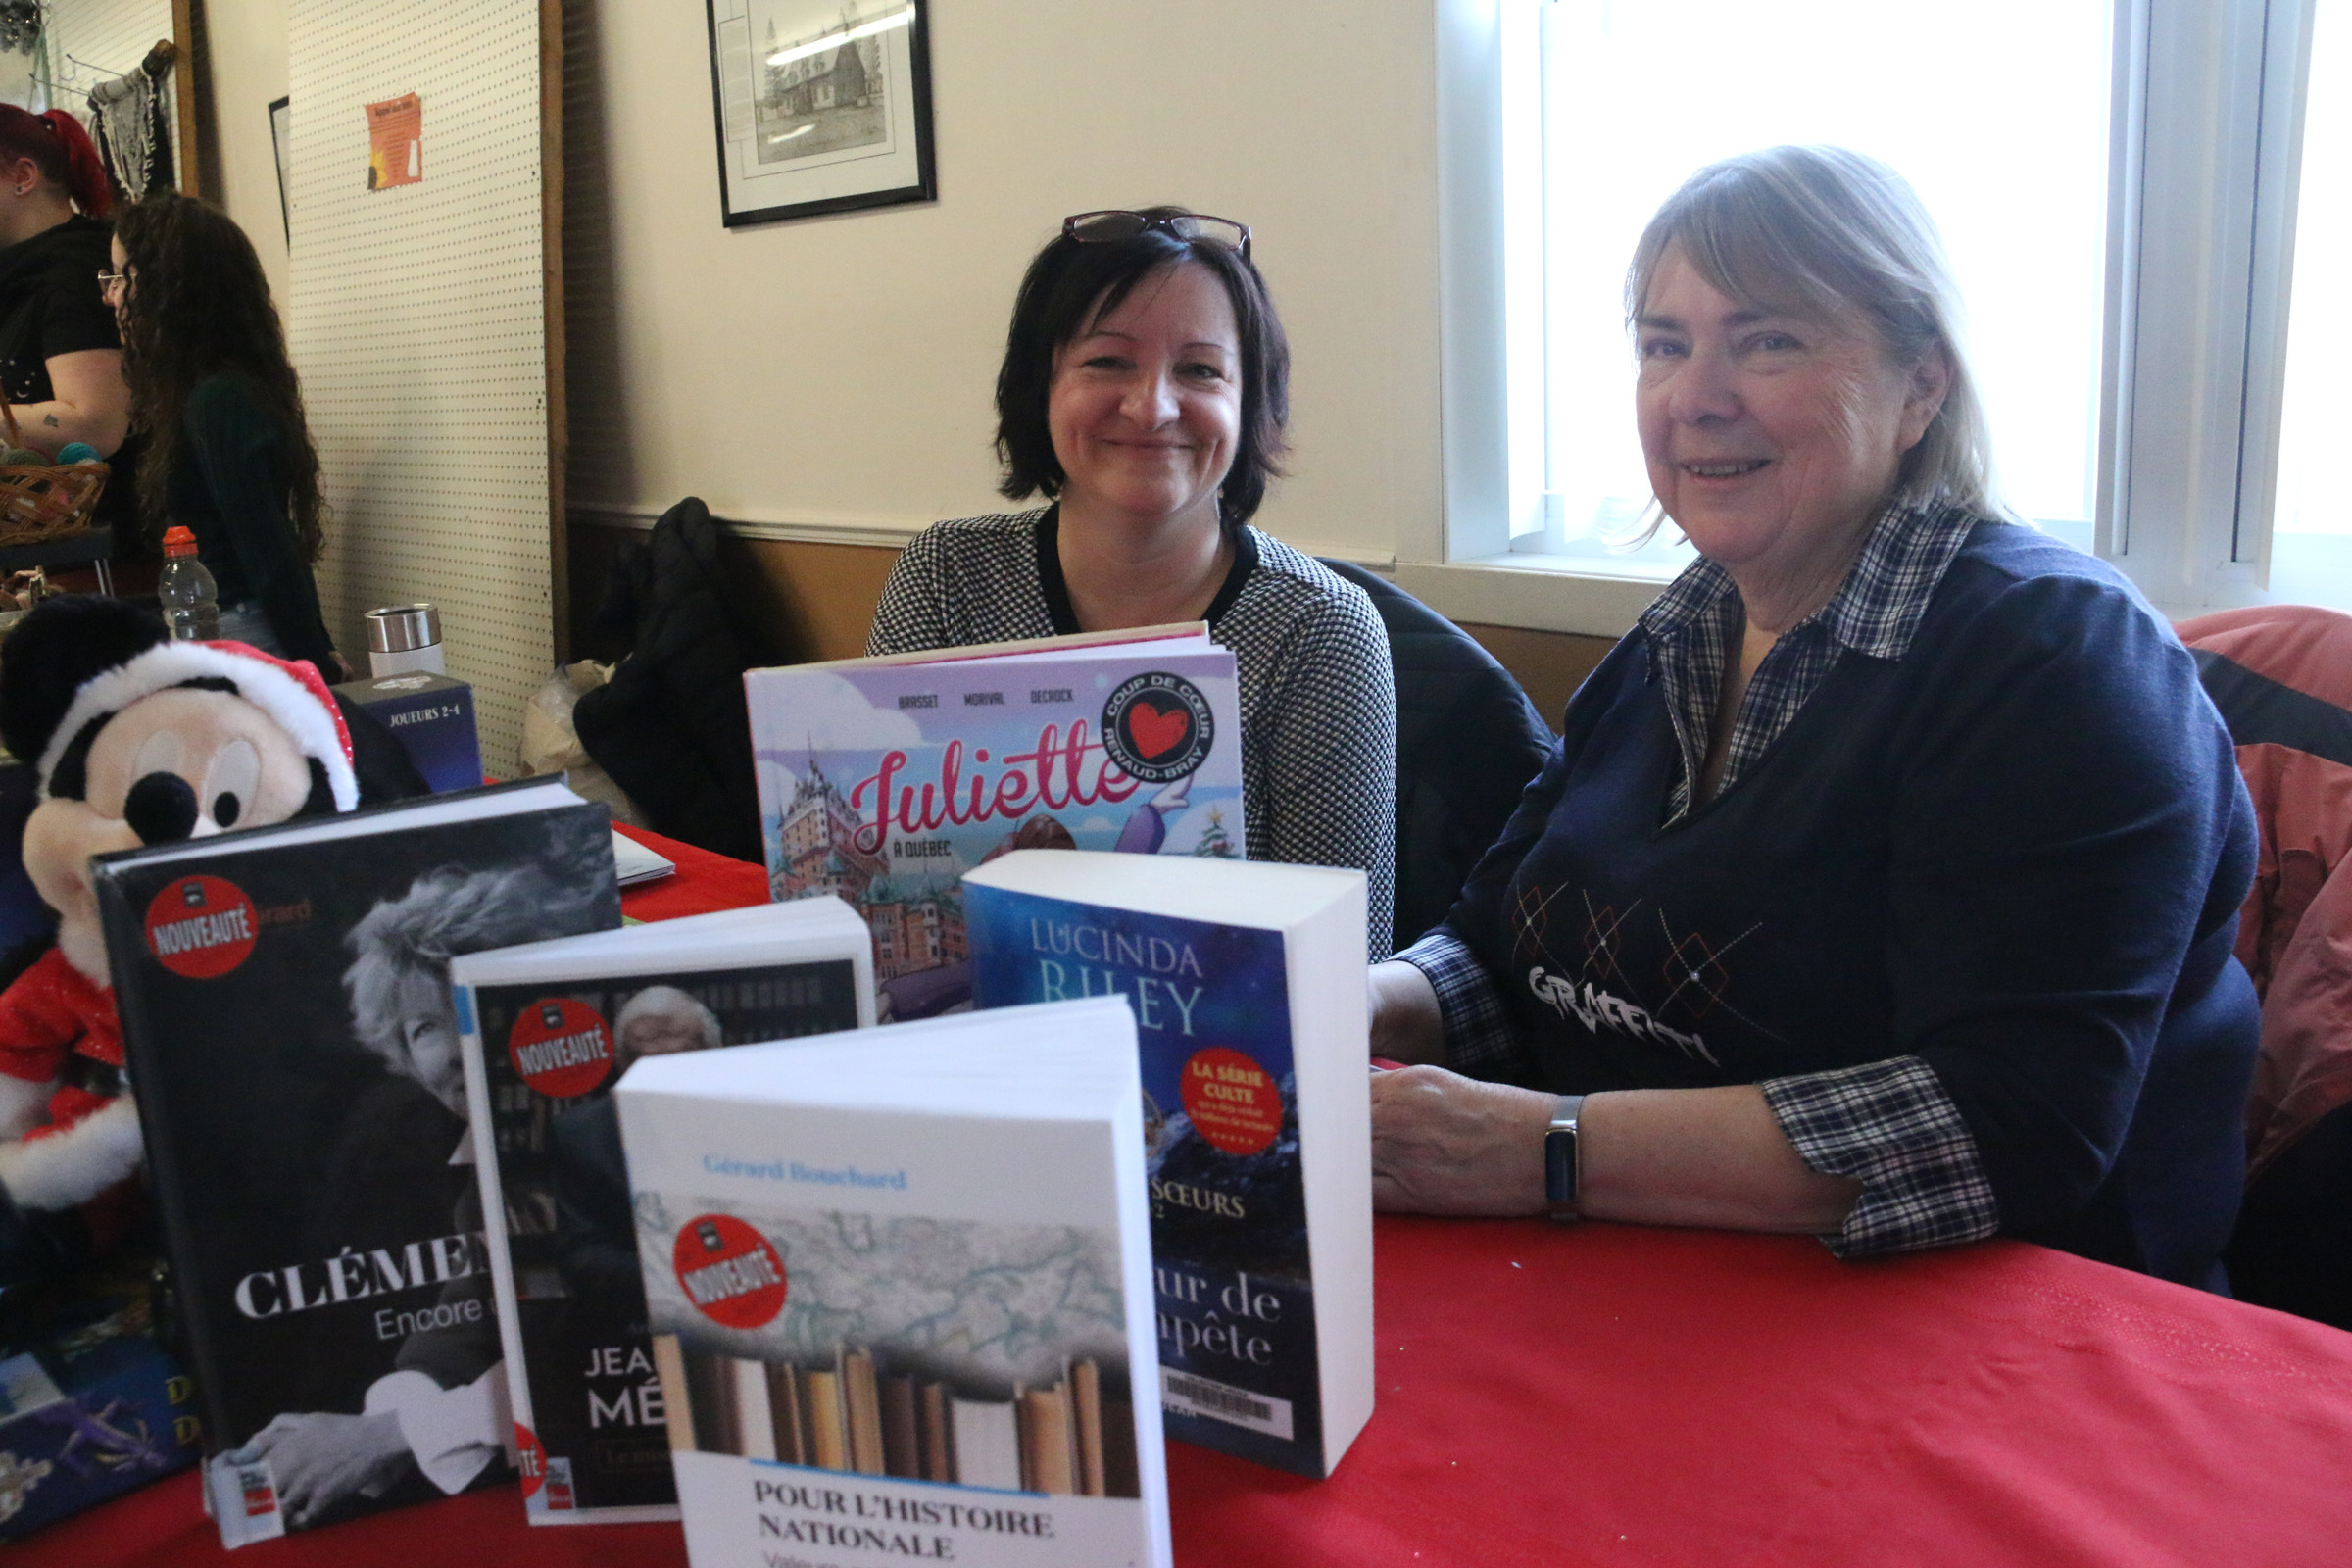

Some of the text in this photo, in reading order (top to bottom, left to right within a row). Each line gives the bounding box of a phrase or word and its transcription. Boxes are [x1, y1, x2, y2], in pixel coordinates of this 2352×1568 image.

[389, 704, 461, 728] JOUEURS 2-4
[898, 694, 939, 709] BRASSET
[963, 692, 1005, 706] MORIVAL
[1106, 675, 1211, 739] COUP DE CŒUR
[1103, 727, 1203, 780] RENAUD-BRAY
[851, 718, 1141, 856] Juliette
[905, 837, 952, 858] QUÉBEC
[153, 902, 252, 956] NOUVEAUTÉ
[1031, 917, 1203, 978] LUCINDA
[516, 1022, 610, 1076] NOUVEAUTÉ
[1192, 1061, 1264, 1088] LA SÉRIE
[1203, 1082, 1255, 1104] CULTE
[703, 1154, 907, 1191] Gérard Bouchard
[1151, 1176, 1247, 1220] SŒURS
[683, 1241, 782, 1305] NOUVEAUTÉ
[1221, 1271, 1282, 1323] de
[374, 1298, 483, 1342] Encore
[754, 1480, 1056, 1539] POUR L'HISTOIRE
[759, 1514, 957, 1560] NATIONALE
